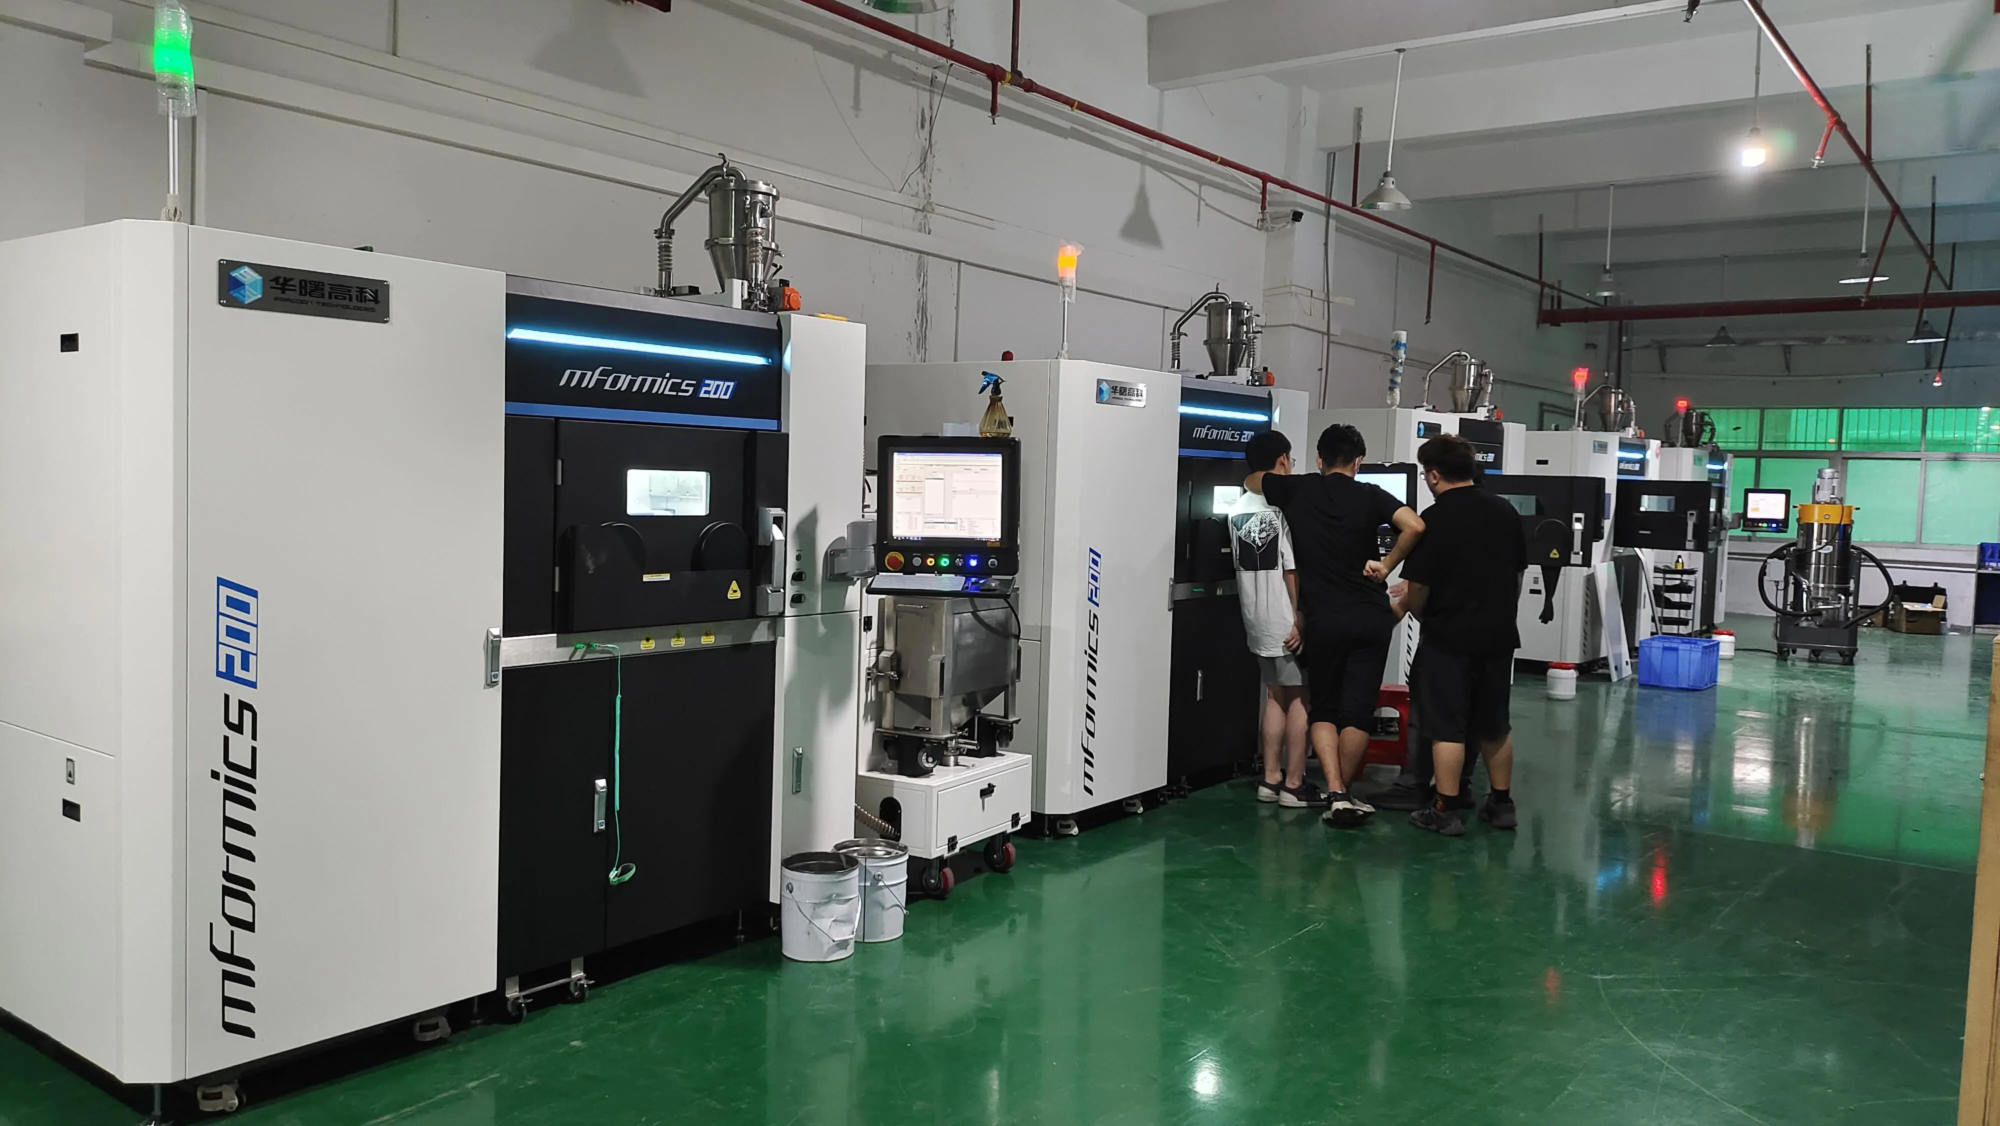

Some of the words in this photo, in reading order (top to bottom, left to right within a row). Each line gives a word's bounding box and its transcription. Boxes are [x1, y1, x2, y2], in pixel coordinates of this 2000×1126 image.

[269, 276, 381, 305] 华曙高科
[699, 379, 736, 400] 200
[1088, 547, 1102, 608] 200
[216, 578, 258, 688] 200
